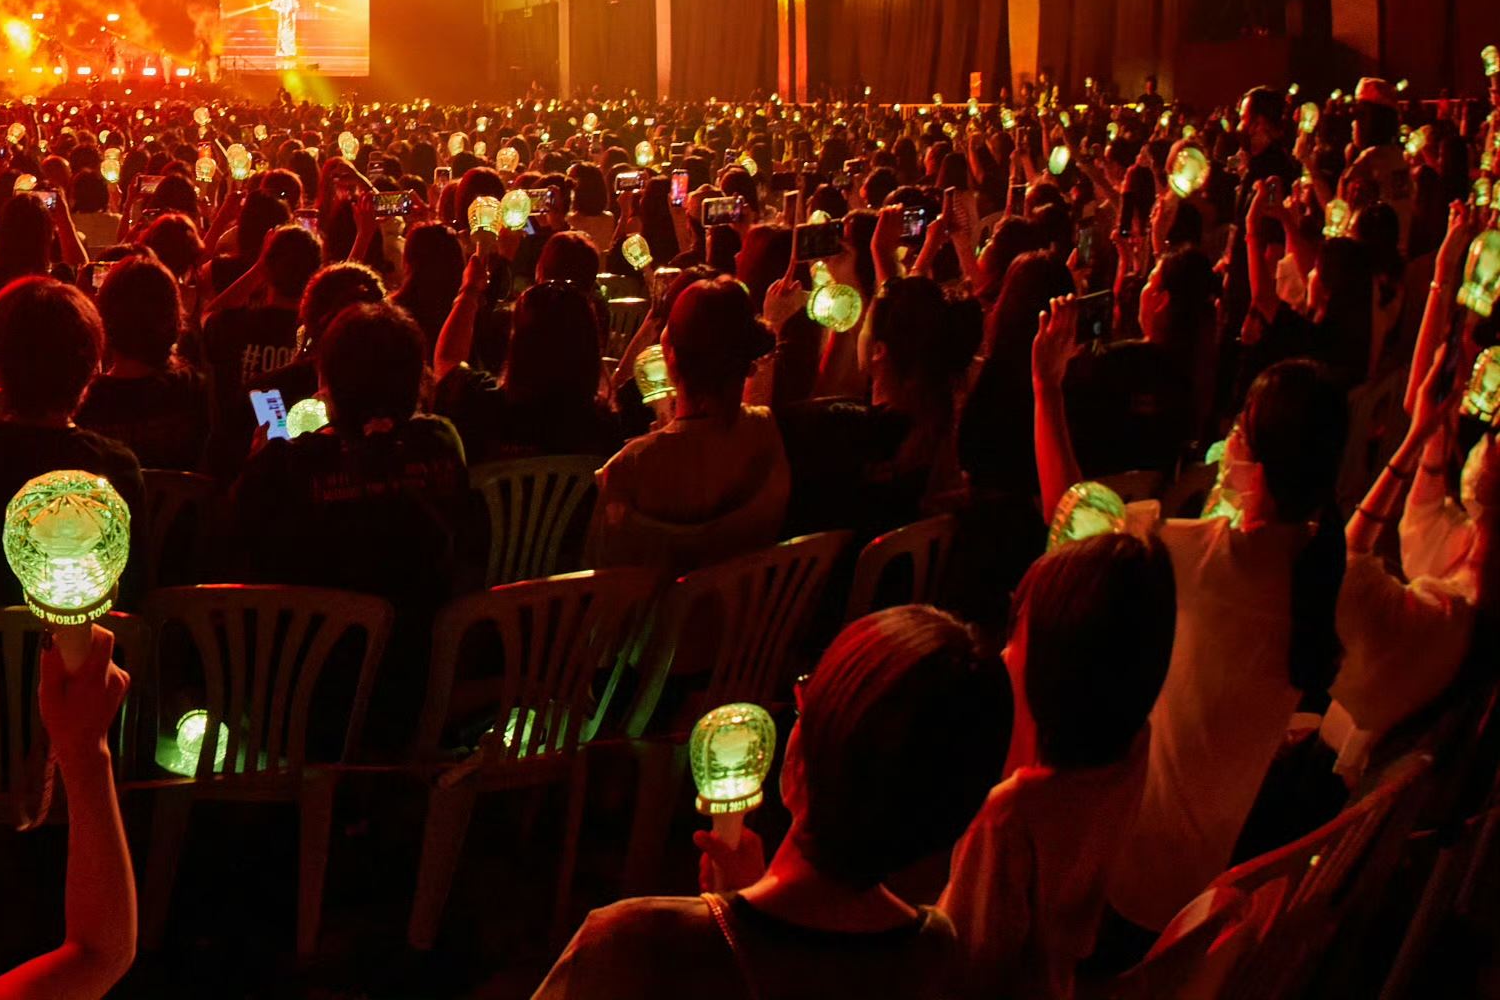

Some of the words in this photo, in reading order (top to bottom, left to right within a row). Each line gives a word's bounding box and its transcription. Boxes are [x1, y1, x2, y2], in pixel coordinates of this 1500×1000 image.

[28, 600, 45, 619] 2023
[46, 612, 87, 625] WORLD
[88, 599, 113, 621] TOUR
